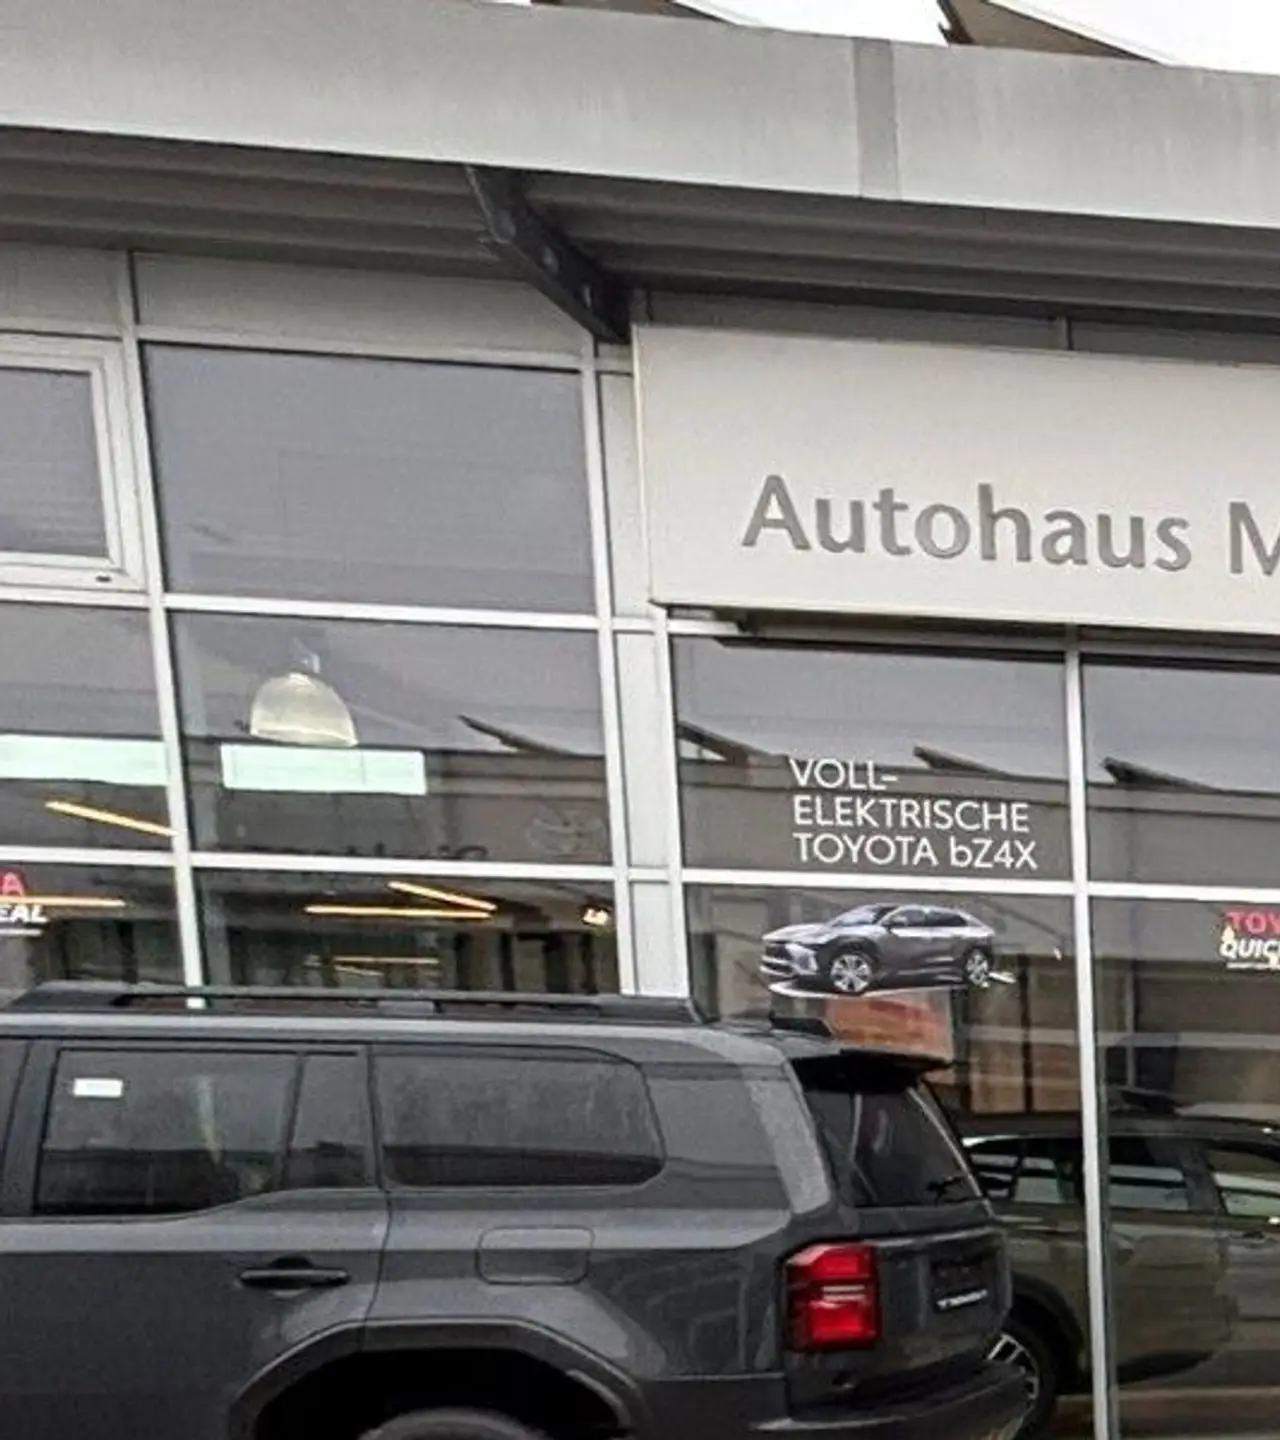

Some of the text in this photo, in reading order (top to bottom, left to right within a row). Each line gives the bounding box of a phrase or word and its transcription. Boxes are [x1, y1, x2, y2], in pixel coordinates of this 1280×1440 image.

[741, 473, 1193, 573] Autohaus
[789, 757, 899, 790] VOLL-
[793, 793, 1031, 833] ELEKTRISCHE
[793, 832, 1039, 870] TOYOTA bZ4X
